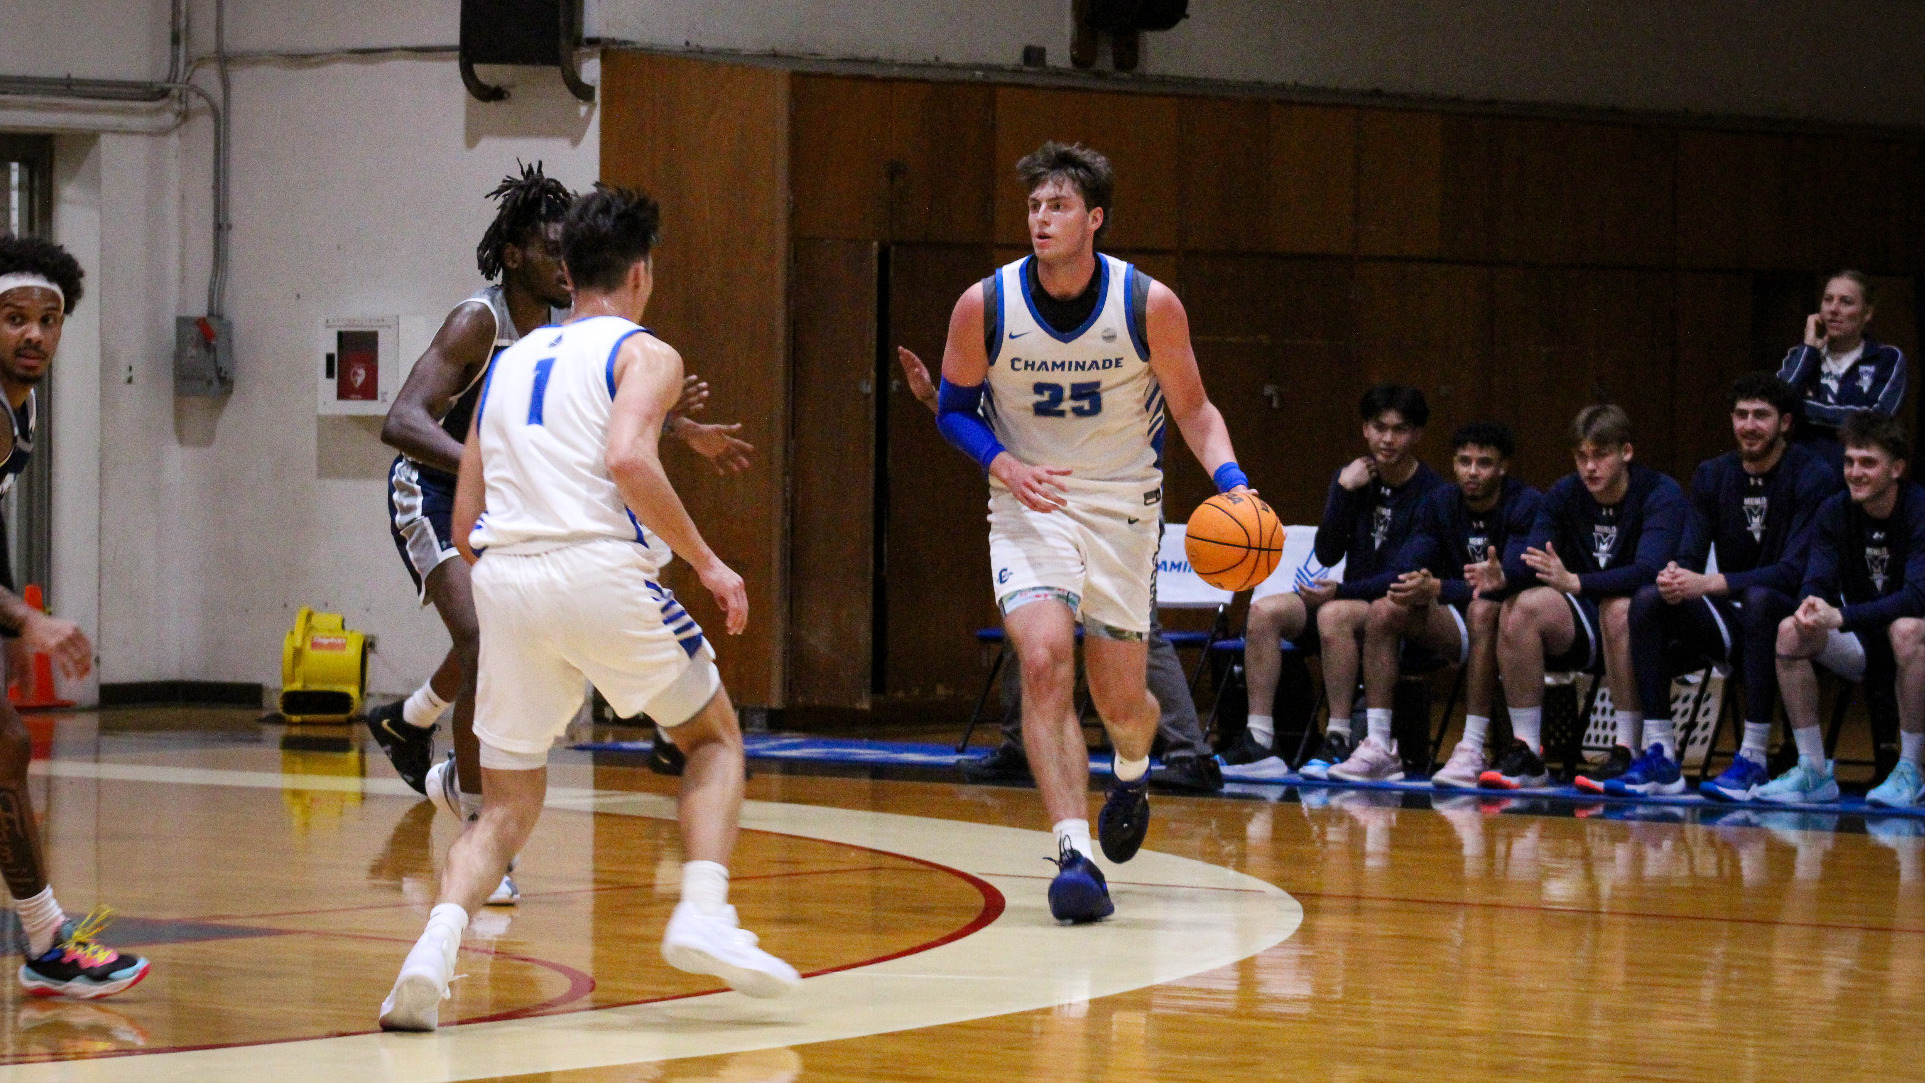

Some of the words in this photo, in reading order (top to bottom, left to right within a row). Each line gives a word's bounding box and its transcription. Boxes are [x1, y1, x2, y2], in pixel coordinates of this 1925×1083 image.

[1010, 357, 1124, 372] CHAMINADE
[527, 357, 556, 425] 1
[1033, 381, 1102, 417] 25
[1157, 560, 1192, 573] AMI
